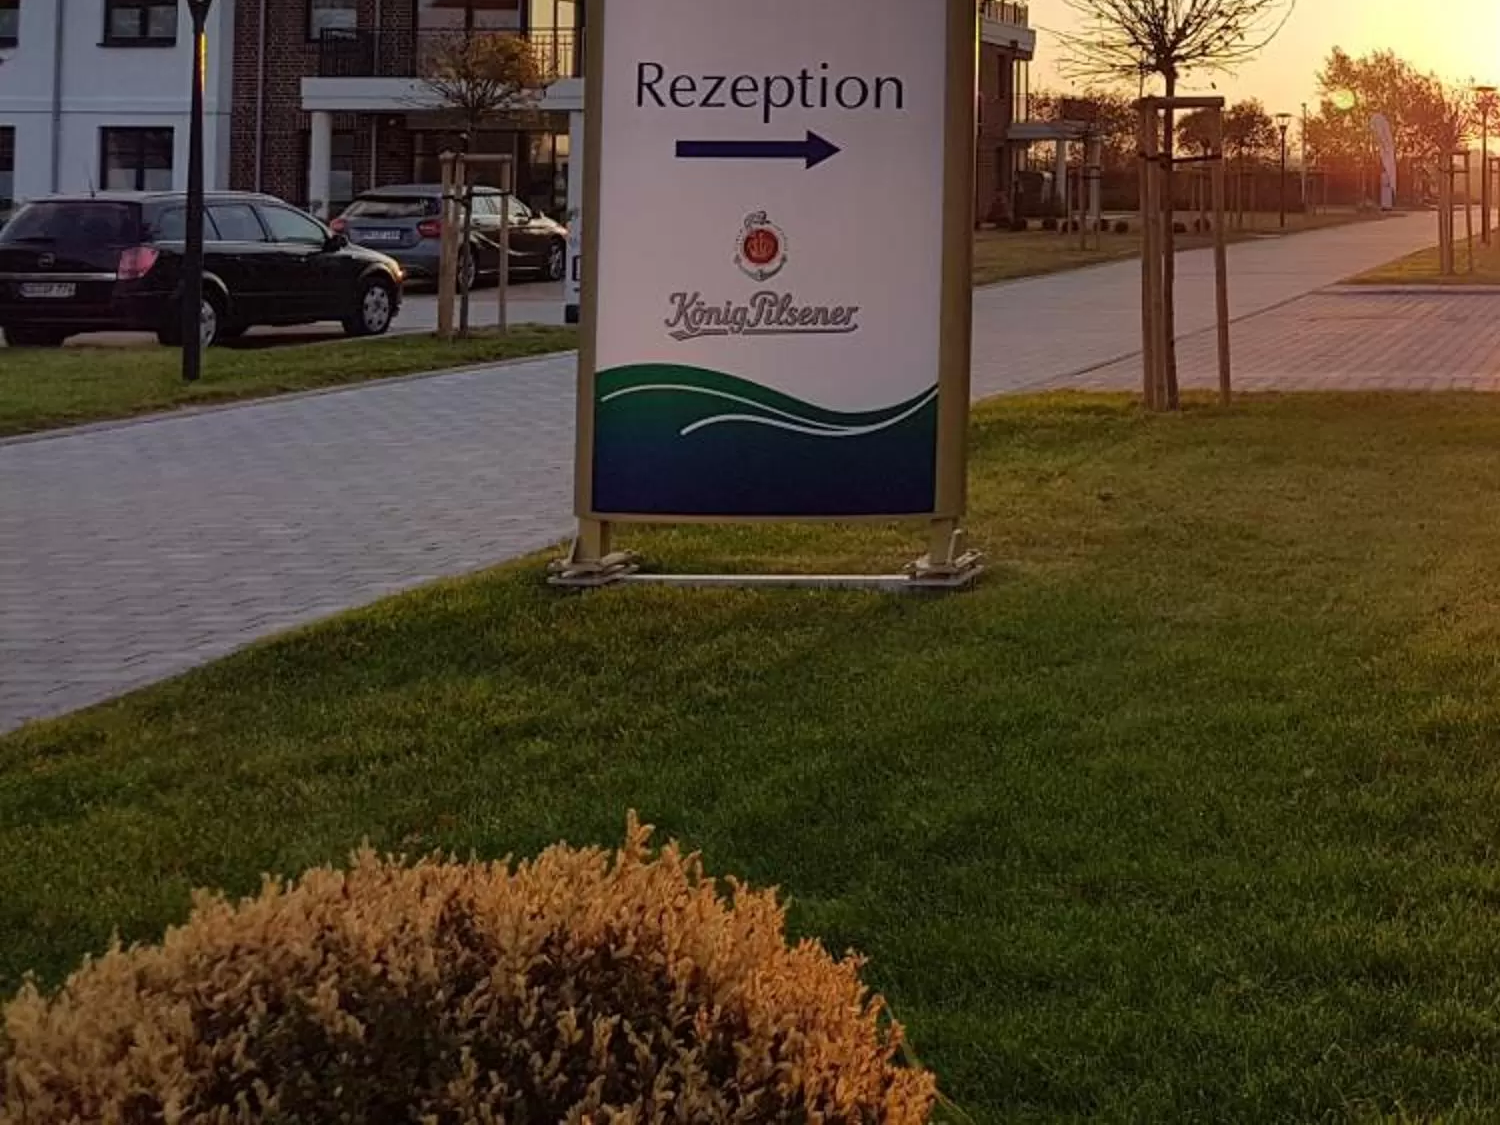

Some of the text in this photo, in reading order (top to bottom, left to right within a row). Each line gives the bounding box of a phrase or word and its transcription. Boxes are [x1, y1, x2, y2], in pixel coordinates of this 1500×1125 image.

[635, 61, 904, 124] Rezeption
[664, 290, 861, 334] König Pilsener
